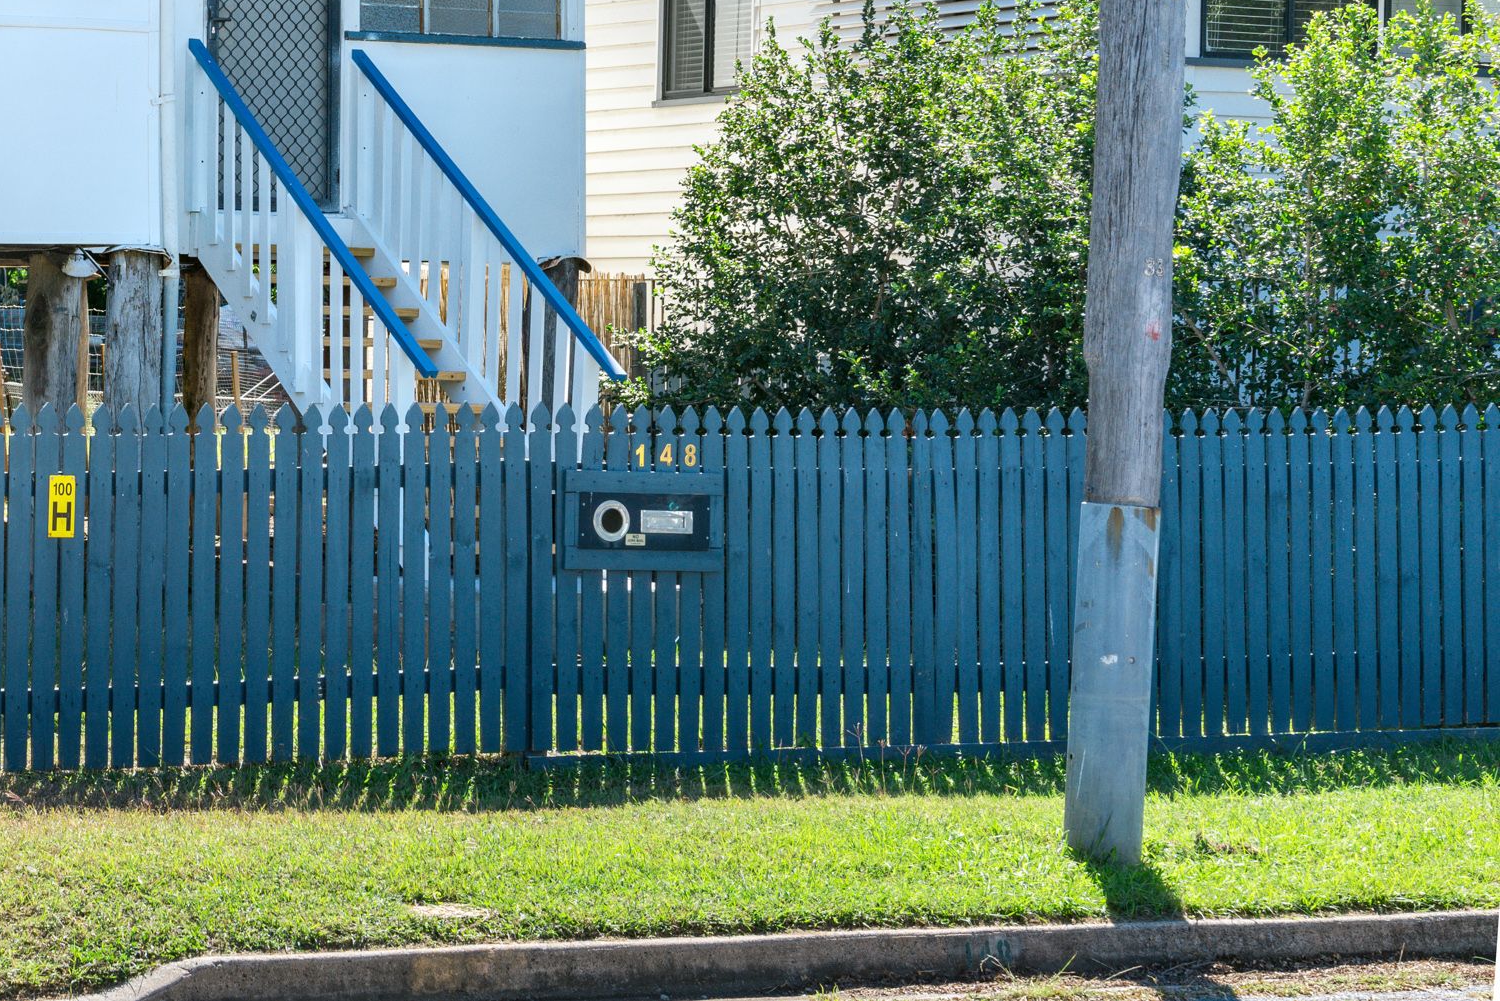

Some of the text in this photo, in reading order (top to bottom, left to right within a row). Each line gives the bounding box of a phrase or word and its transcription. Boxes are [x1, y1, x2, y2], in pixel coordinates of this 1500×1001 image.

[635, 443, 697, 467] 148
[53, 482, 73, 496] 100
[52, 501, 72, 532] H
